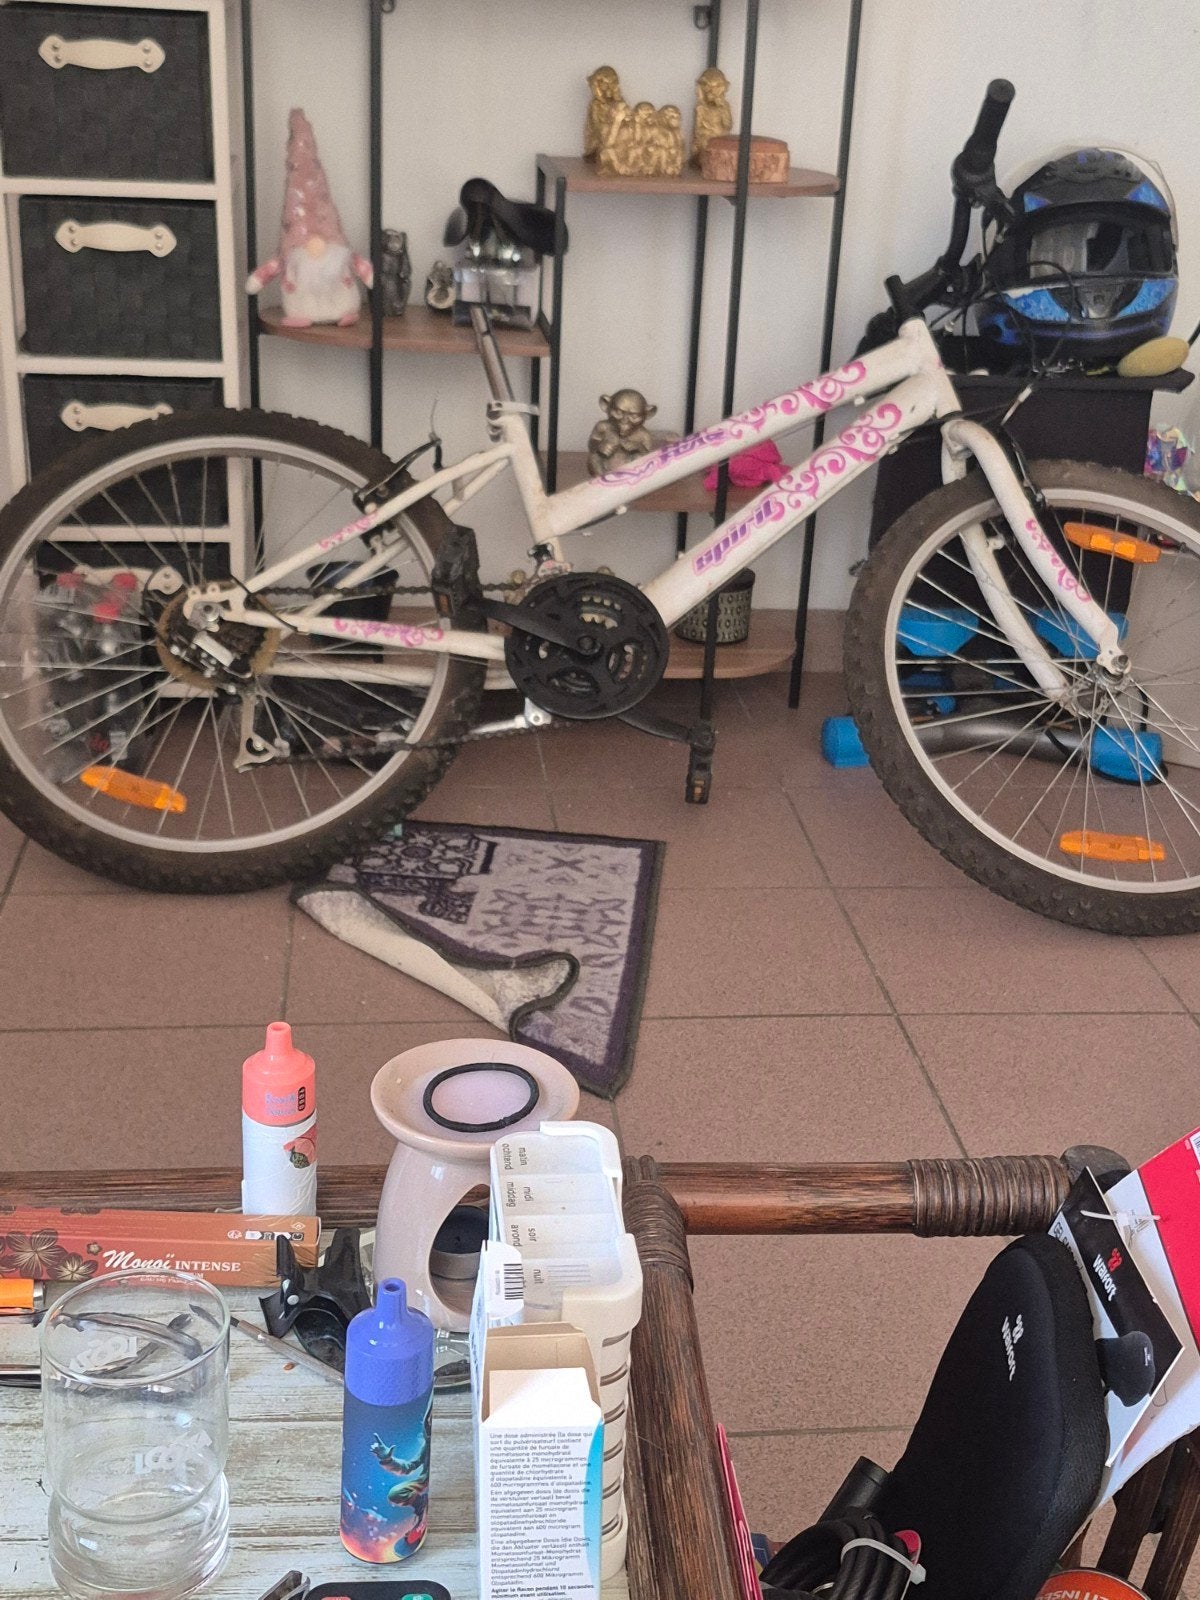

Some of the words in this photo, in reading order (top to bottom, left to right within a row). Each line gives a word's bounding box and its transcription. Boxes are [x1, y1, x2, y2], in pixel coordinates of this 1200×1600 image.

[502, 1143, 513, 1171] ochtend
[519, 1147, 528, 1166] matin
[506, 1181, 517, 1208] middag
[523, 1186, 534, 1202] midi
[511, 1224, 523, 1247] avond
[528, 1227, 537, 1242] soir
[175, 1260, 241, 1272] INTENSE
[533, 1269, 544, 1285] nuit
